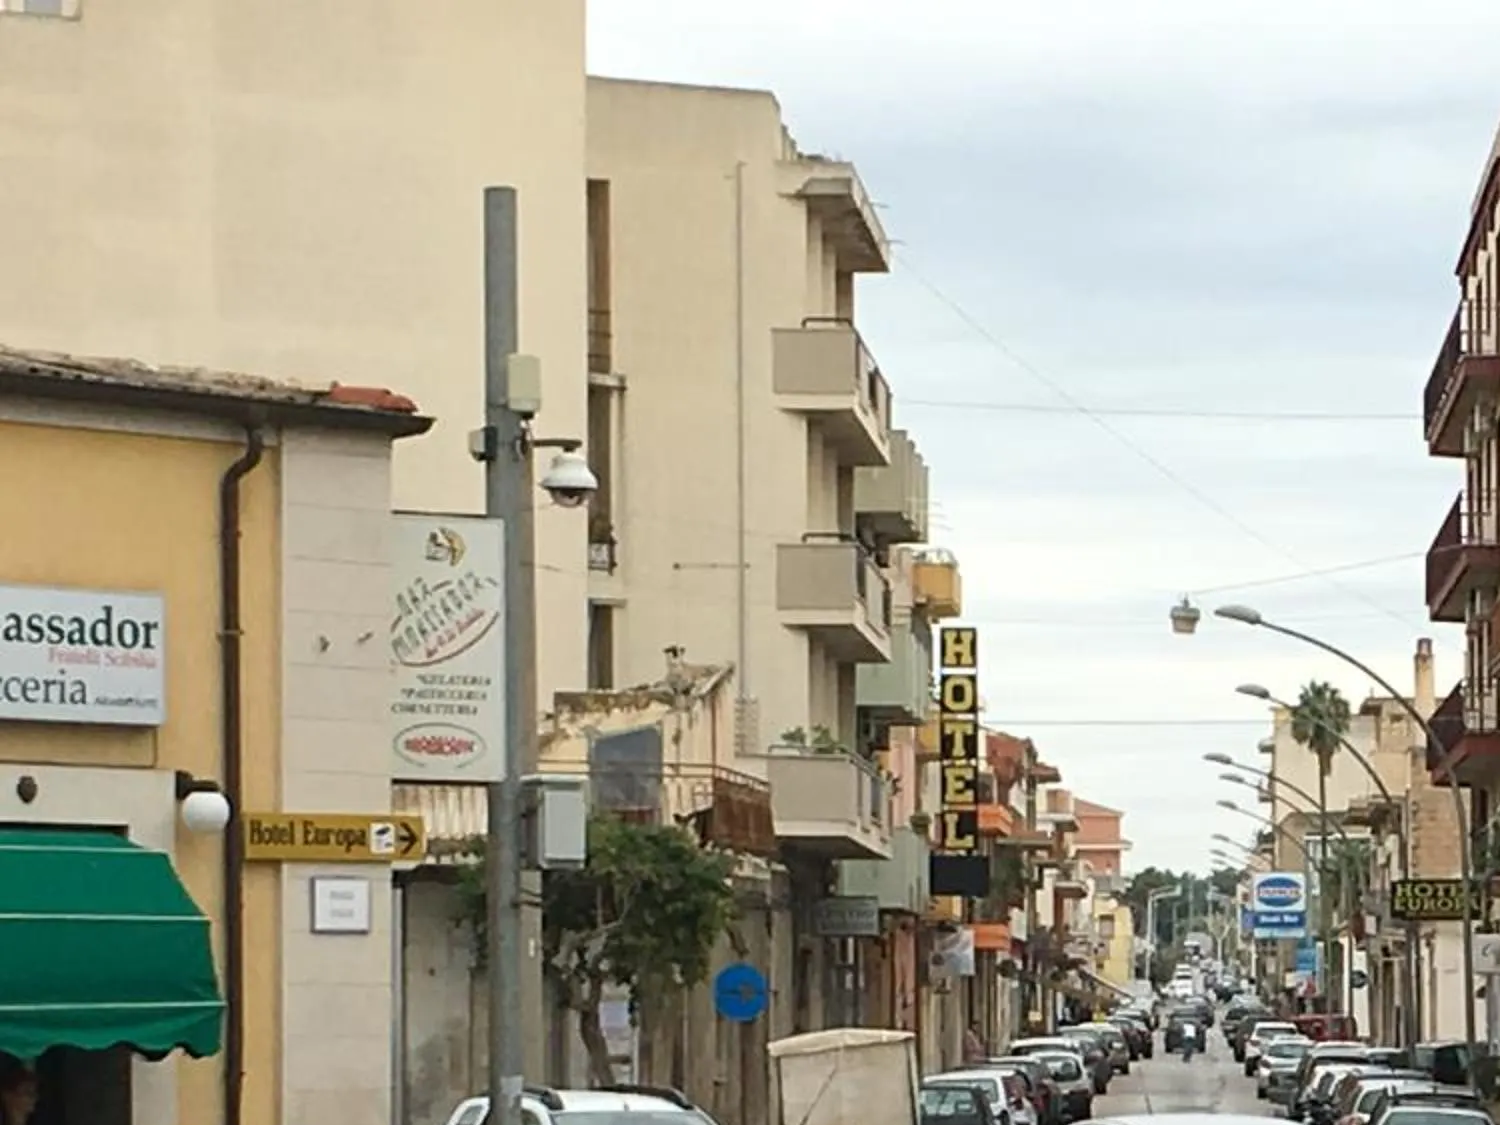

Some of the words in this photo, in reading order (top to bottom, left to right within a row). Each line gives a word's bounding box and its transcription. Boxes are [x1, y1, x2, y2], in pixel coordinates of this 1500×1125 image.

[0, 604, 158, 650] assador
[0, 668, 87, 705] ceria
[942, 630, 975, 849] HOTEL
[249, 820, 295, 846] Hotel
[302, 820, 366, 852] Europa
